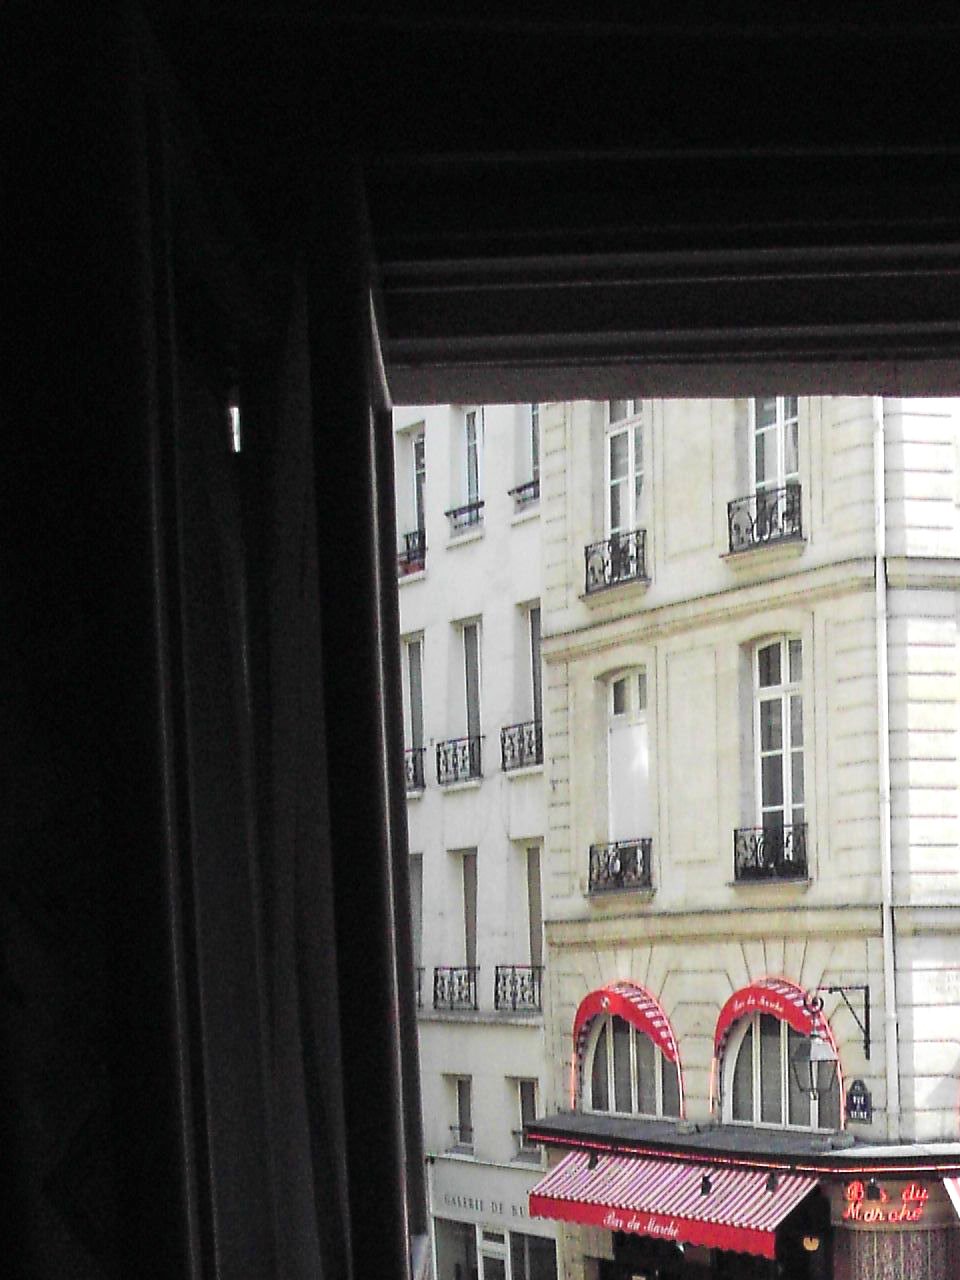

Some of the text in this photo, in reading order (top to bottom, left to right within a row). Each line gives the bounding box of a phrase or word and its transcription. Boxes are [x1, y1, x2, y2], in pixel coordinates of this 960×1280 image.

[901, 1182, 929, 1201] du
[603, 1211, 623, 1229] Bar
[627, 1213, 641, 1231] du
